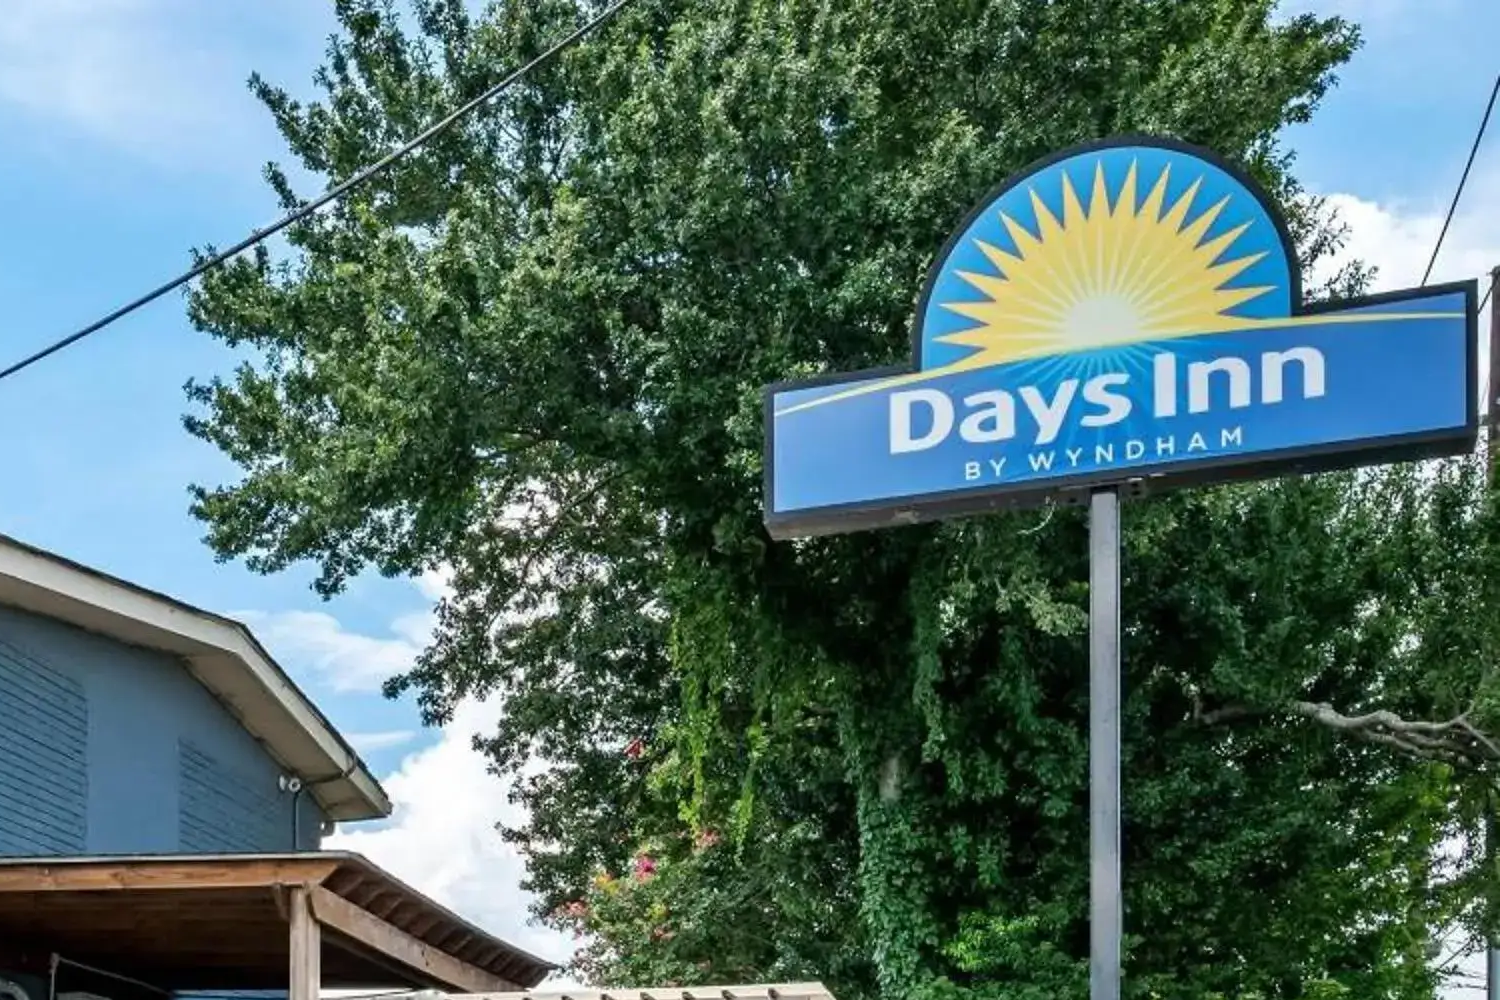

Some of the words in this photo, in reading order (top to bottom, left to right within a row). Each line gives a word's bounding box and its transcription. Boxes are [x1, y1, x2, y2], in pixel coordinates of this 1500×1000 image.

[889, 371, 1132, 455] Days
[1153, 345, 1326, 418] Inn
[965, 457, 1008, 481] BY
[1029, 426, 1242, 473] WYNDHAM
